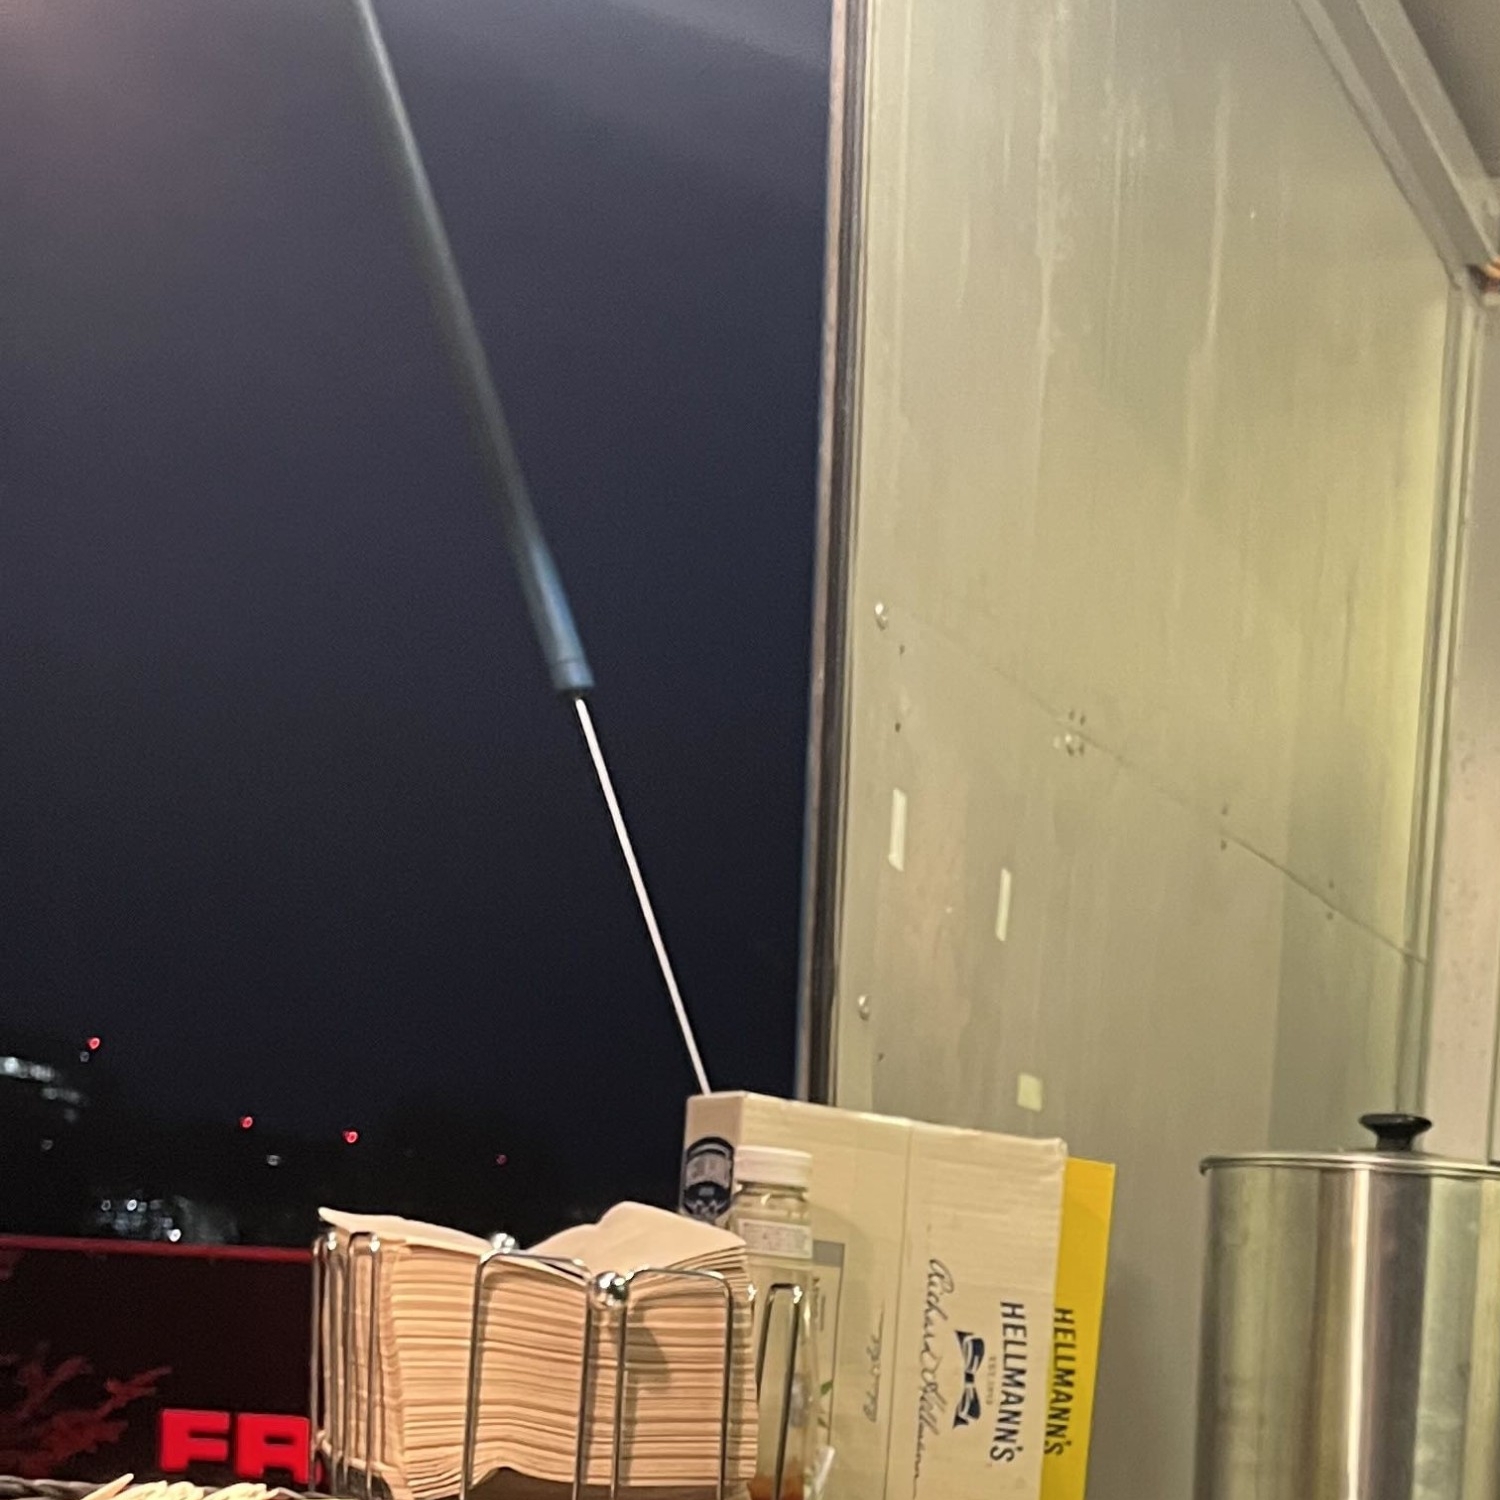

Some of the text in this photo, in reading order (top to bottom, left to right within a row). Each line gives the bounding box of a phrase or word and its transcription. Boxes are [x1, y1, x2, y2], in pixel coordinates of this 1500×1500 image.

[160, 1408, 322, 1486] FA
[990, 1301, 1028, 1463] HELLMANN'S
[1043, 1307, 1077, 1457] HELLMANN'S
